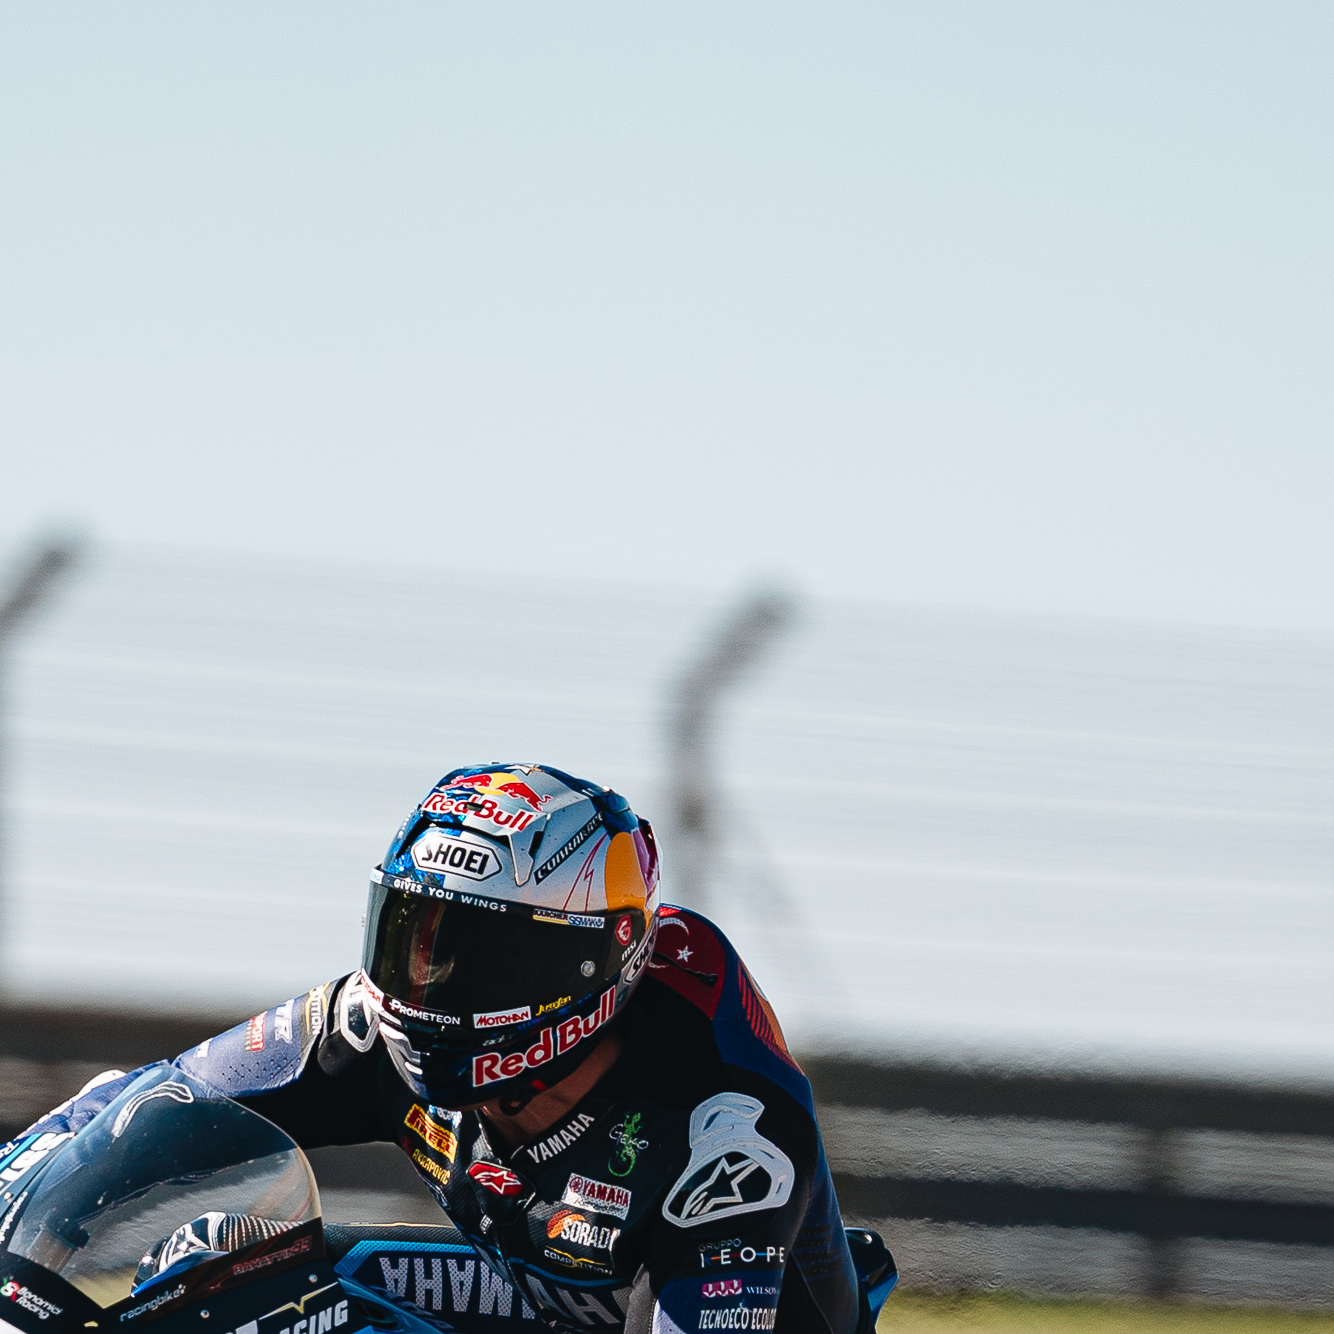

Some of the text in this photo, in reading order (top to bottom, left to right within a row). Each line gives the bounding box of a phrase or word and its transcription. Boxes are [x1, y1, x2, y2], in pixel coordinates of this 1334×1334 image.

[423, 792, 534, 831] Red Bull
[421, 841, 490, 875] SHOEI
[394, 875, 423, 894] GIVES
[428, 886, 454, 900] YOU
[461, 895, 507, 913] WINGS
[389, 998, 461, 1026] PROMETEON
[473, 985, 616, 1087] Red Bull
[527, 1113, 595, 1163] YAMAHA
[582, 1180, 629, 1208] YAMAHA
[698, 1238, 742, 1252] GRUPPO
[16, 1296, 50, 1320] Racing
[120, 1286, 184, 1322] racingbike
